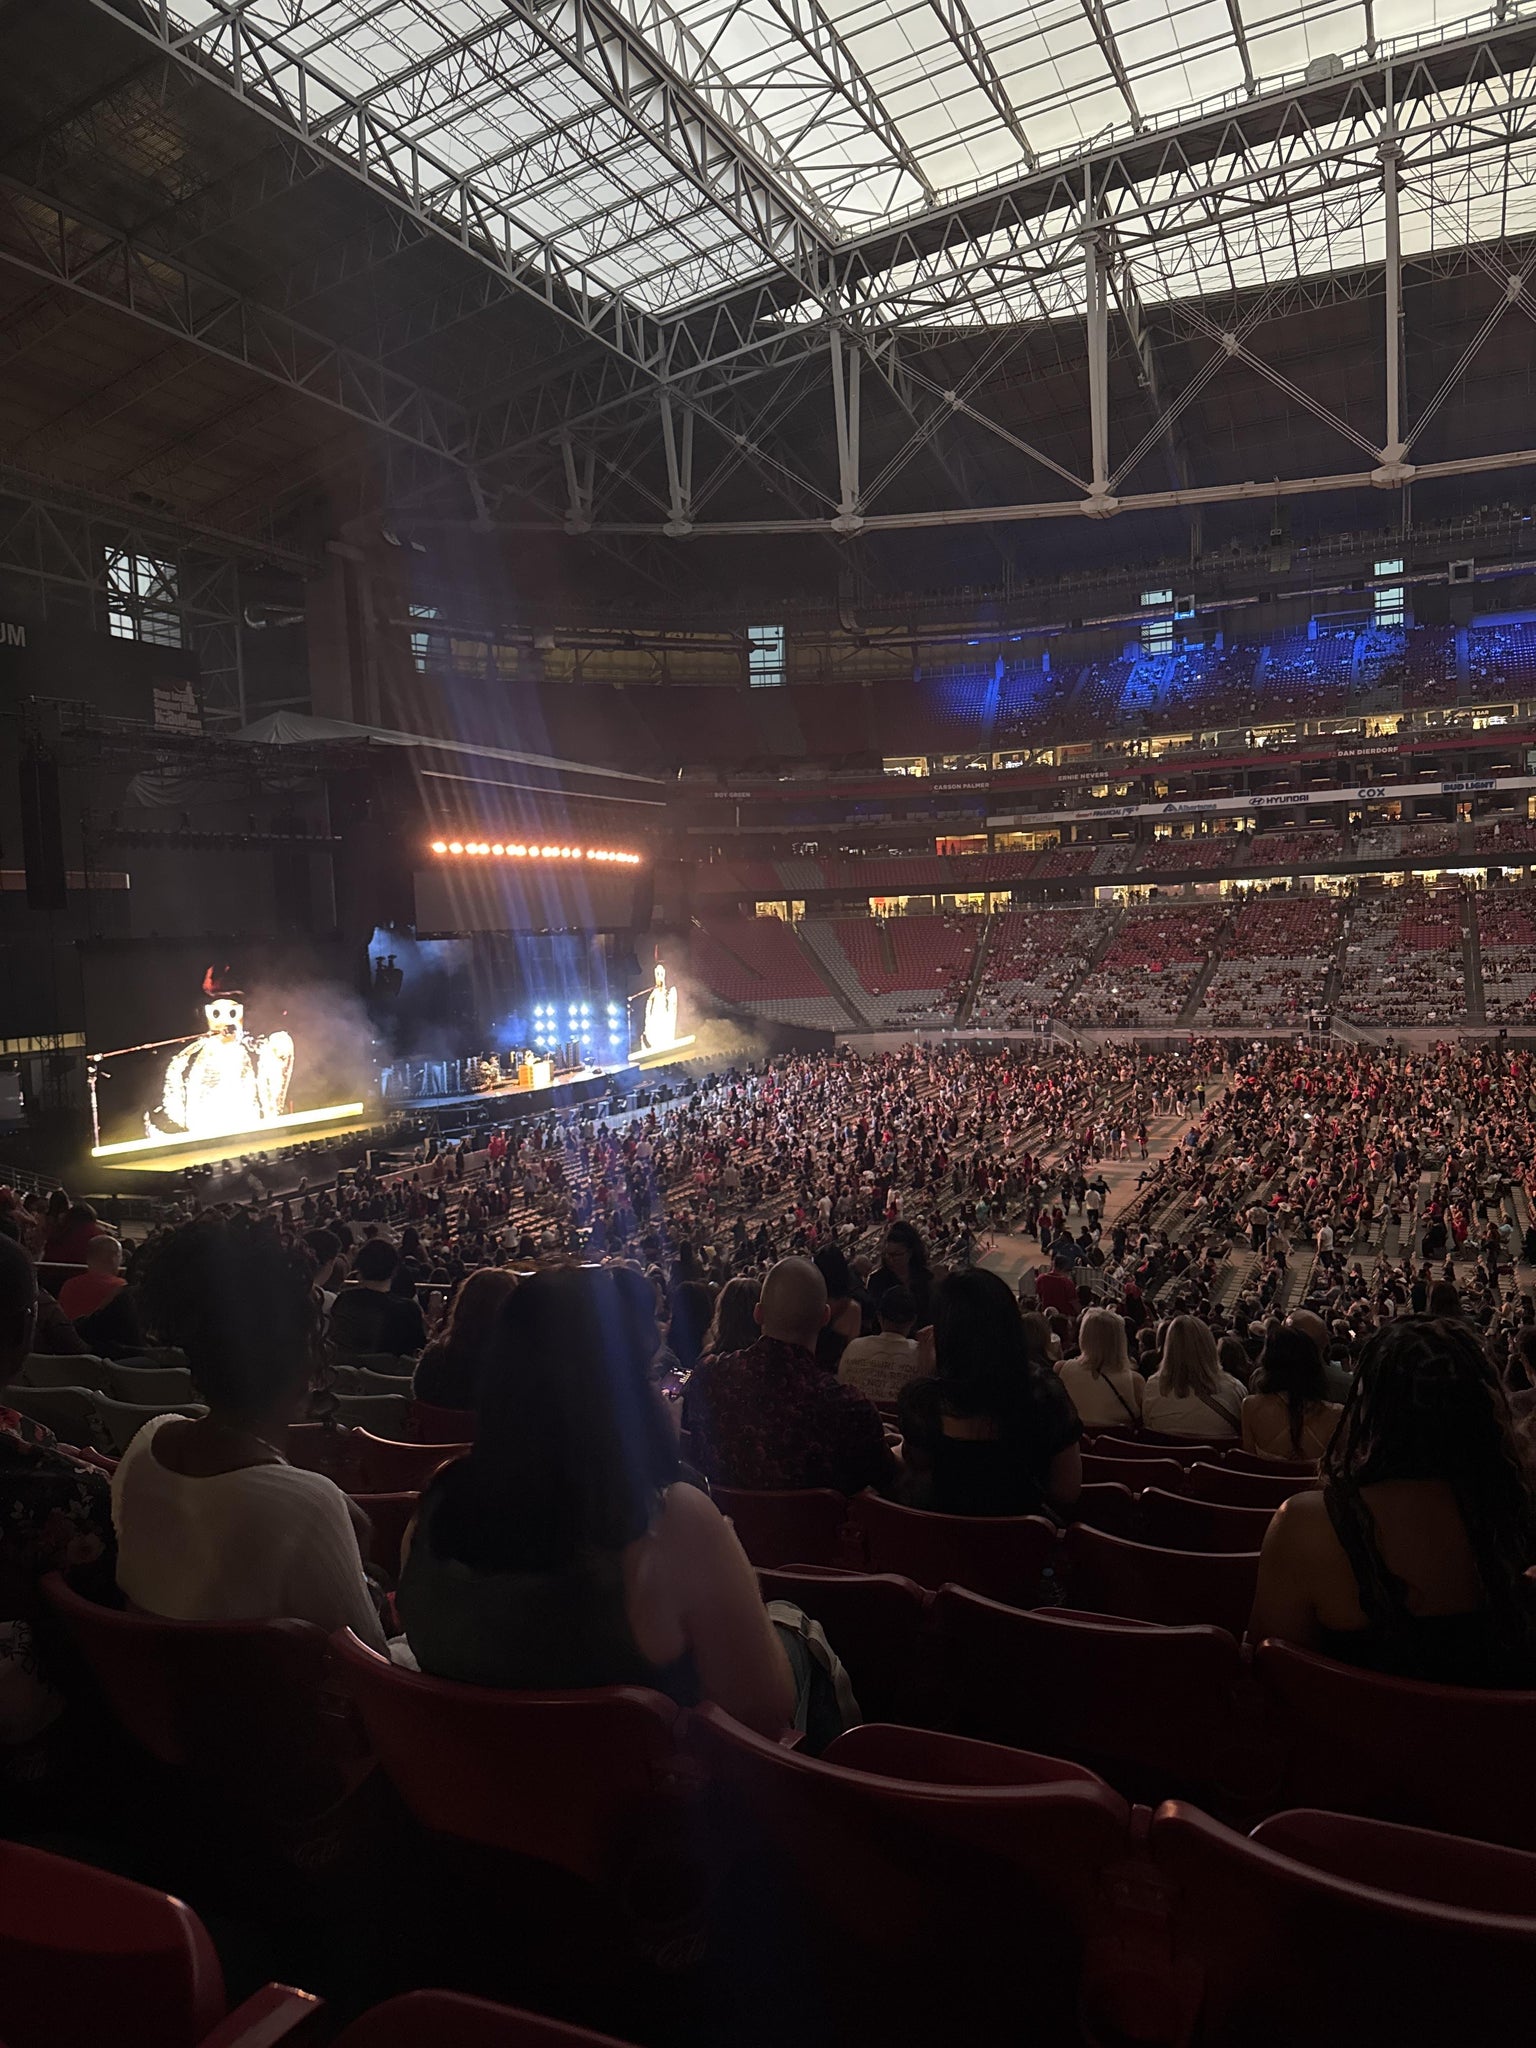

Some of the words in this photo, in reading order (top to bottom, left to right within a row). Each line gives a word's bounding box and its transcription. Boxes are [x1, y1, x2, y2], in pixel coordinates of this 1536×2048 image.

[1337, 749, 1355, 757] DAN
[1357, 746, 1399, 756] DIERDORF
[1443, 782, 1464, 791] BUD
[1465, 781, 1494, 790] LIGHT
[1358, 788, 1386, 798] COX
[1266, 794, 1309, 804] HYUNDAI
